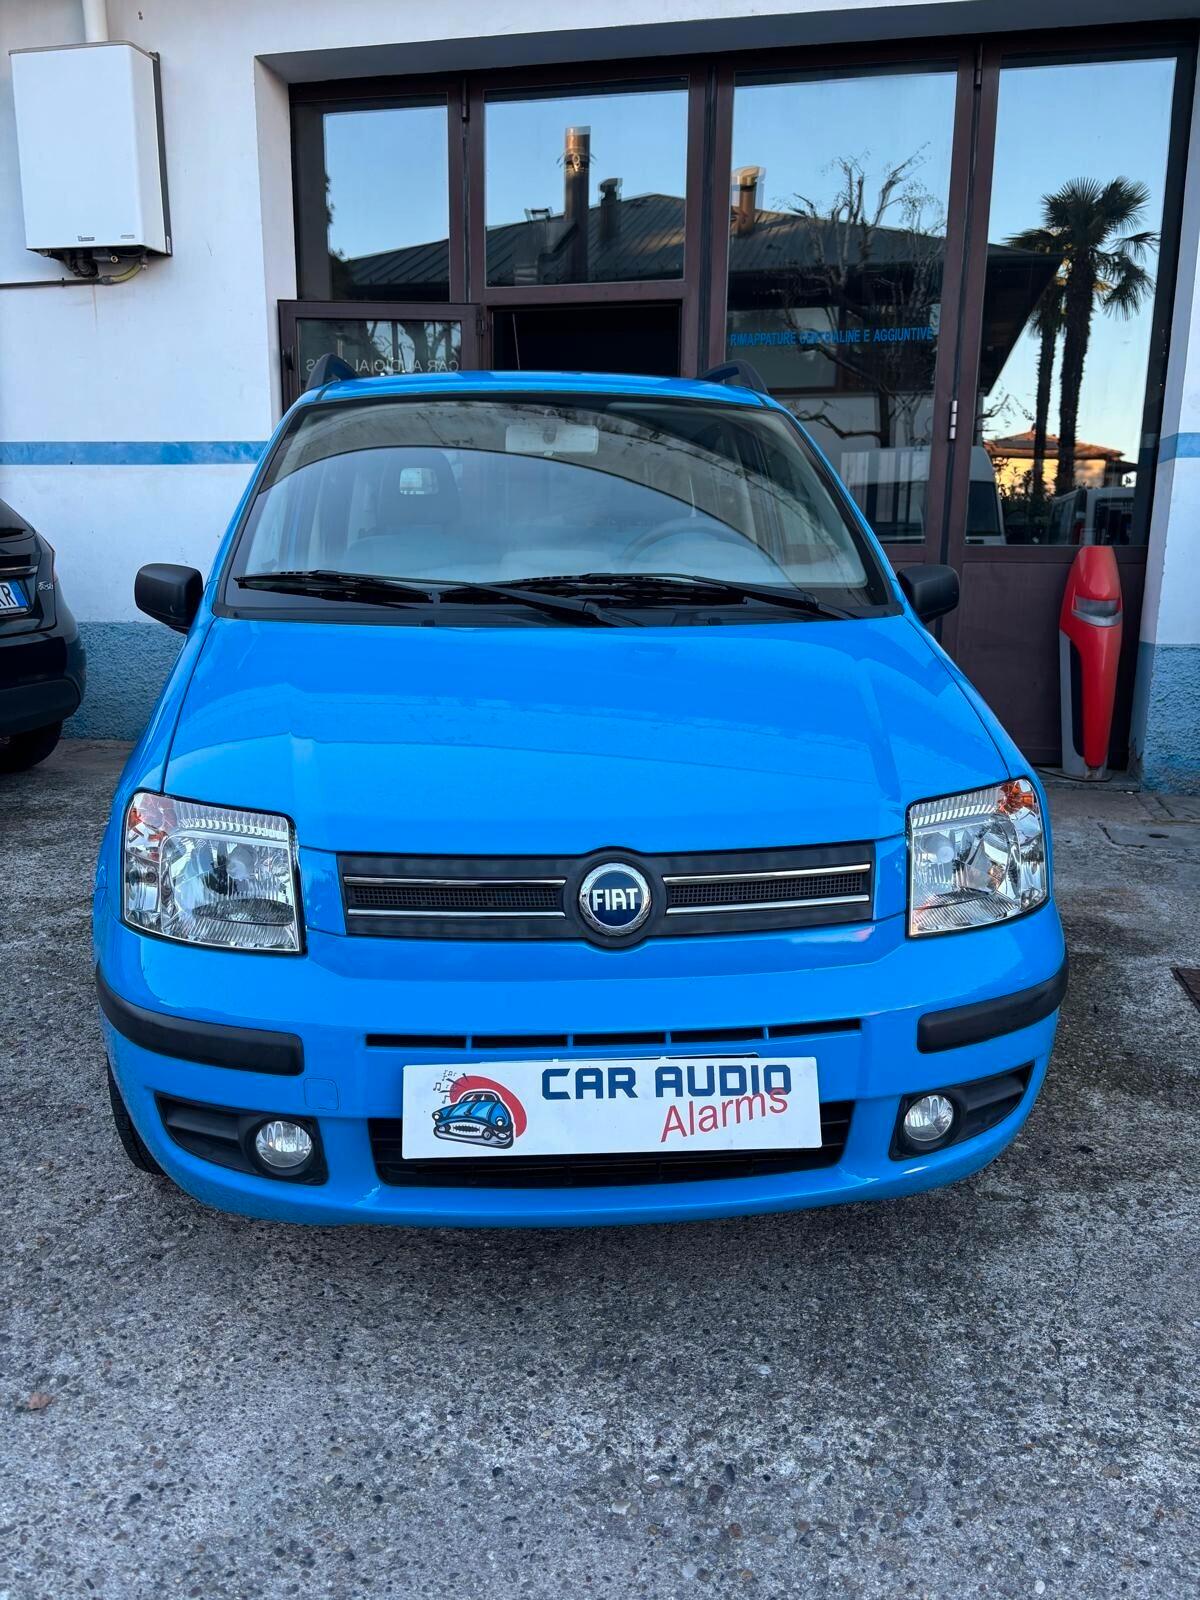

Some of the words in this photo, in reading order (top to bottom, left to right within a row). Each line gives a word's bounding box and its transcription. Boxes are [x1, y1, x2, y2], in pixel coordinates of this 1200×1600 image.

[730, 331, 797, 347] RIMAPPATURE
[863, 329, 870, 342] E
[873, 326, 933, 342] AGGIUNTIVE
[592, 887, 639, 912] FIAT
[541, 1066, 639, 1100] CAR
[654, 1064, 792, 1098] AUDIO
[660, 1086, 788, 1143] Alarms
